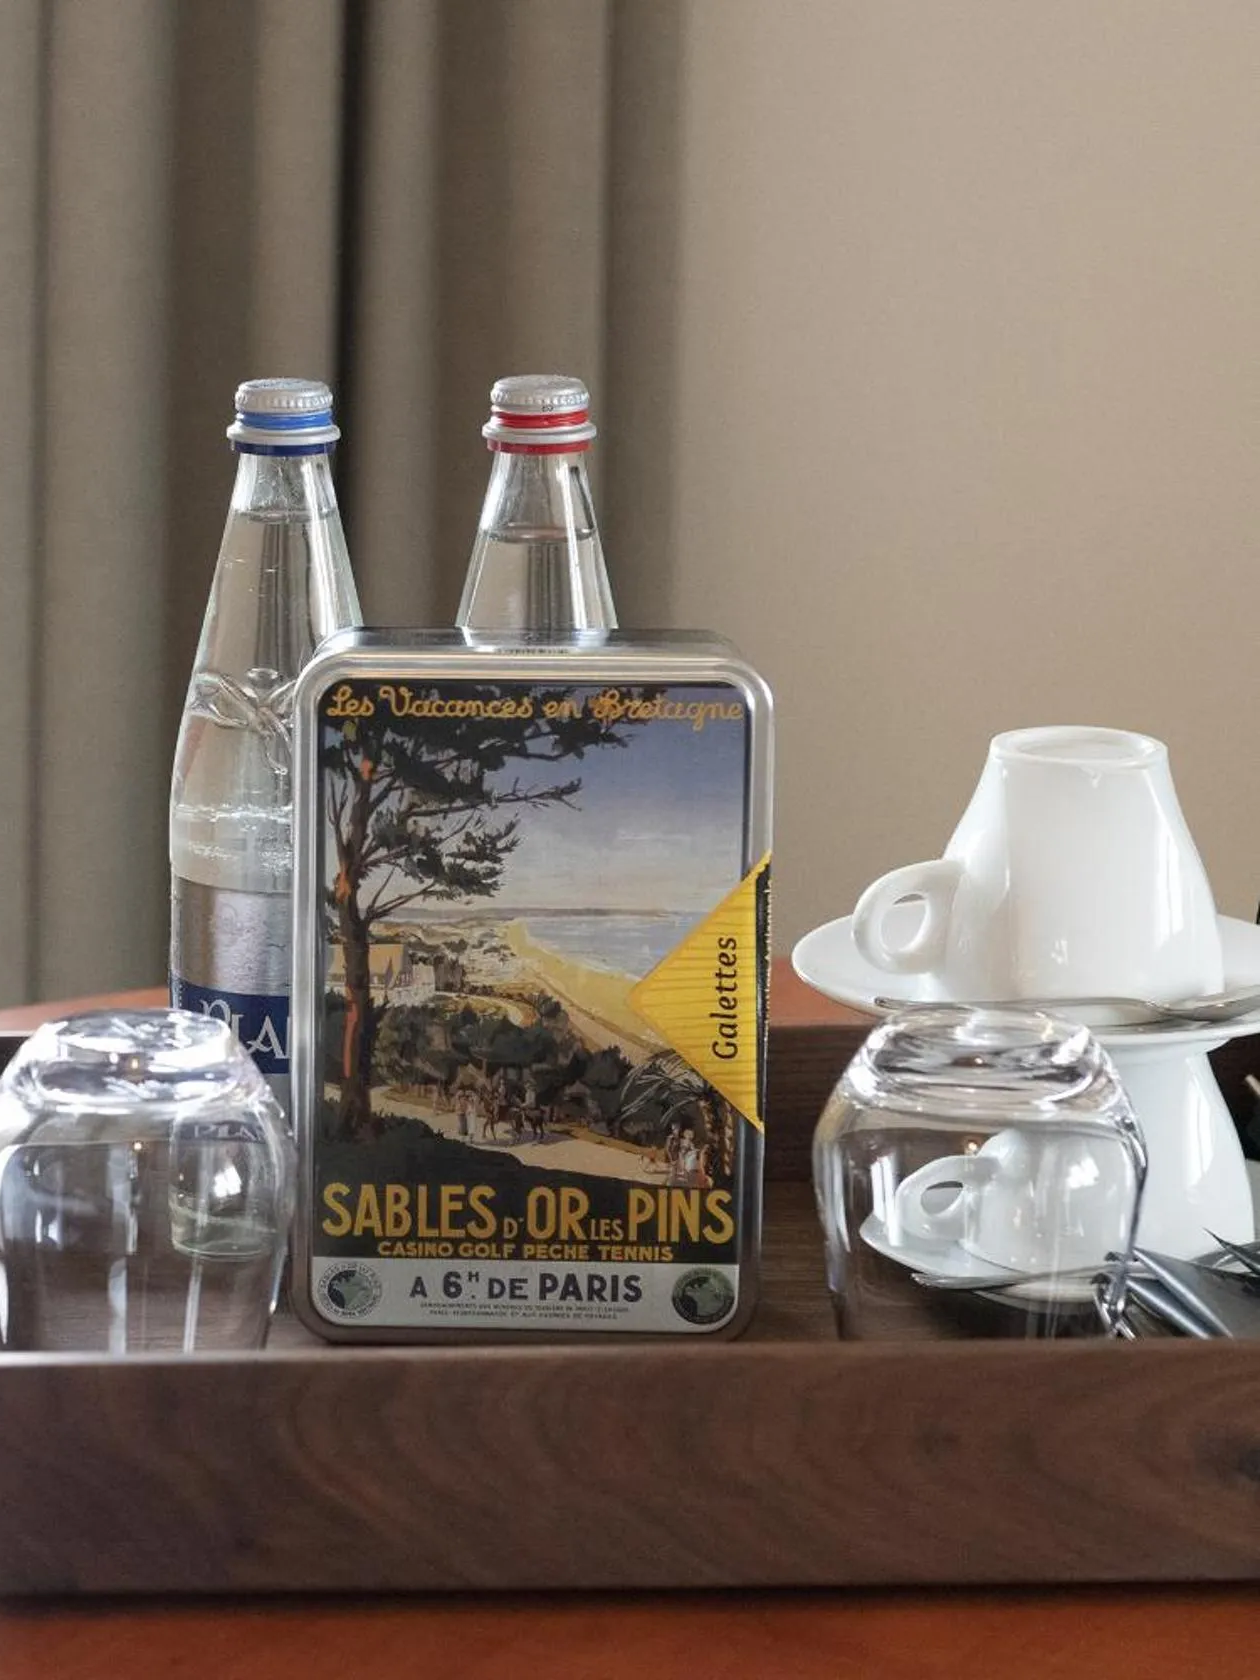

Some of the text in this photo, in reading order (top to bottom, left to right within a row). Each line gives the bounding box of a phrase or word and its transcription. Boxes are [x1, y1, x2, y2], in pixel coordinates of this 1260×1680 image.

[326, 685, 743, 732] Les Vacances en Bretagne
[709, 936, 738, 1060] Galettes
[322, 1182, 497, 1239] SABLES
[591, 1218, 624, 1241] LES
[629, 1188, 734, 1244] PINS
[378, 1241, 674, 1262] CASINO GOLF PECHE TENNIS
[409, 1275, 428, 1298] A
[488, 1277, 529, 1300] DE
[539, 1272, 643, 1303] PARIS
